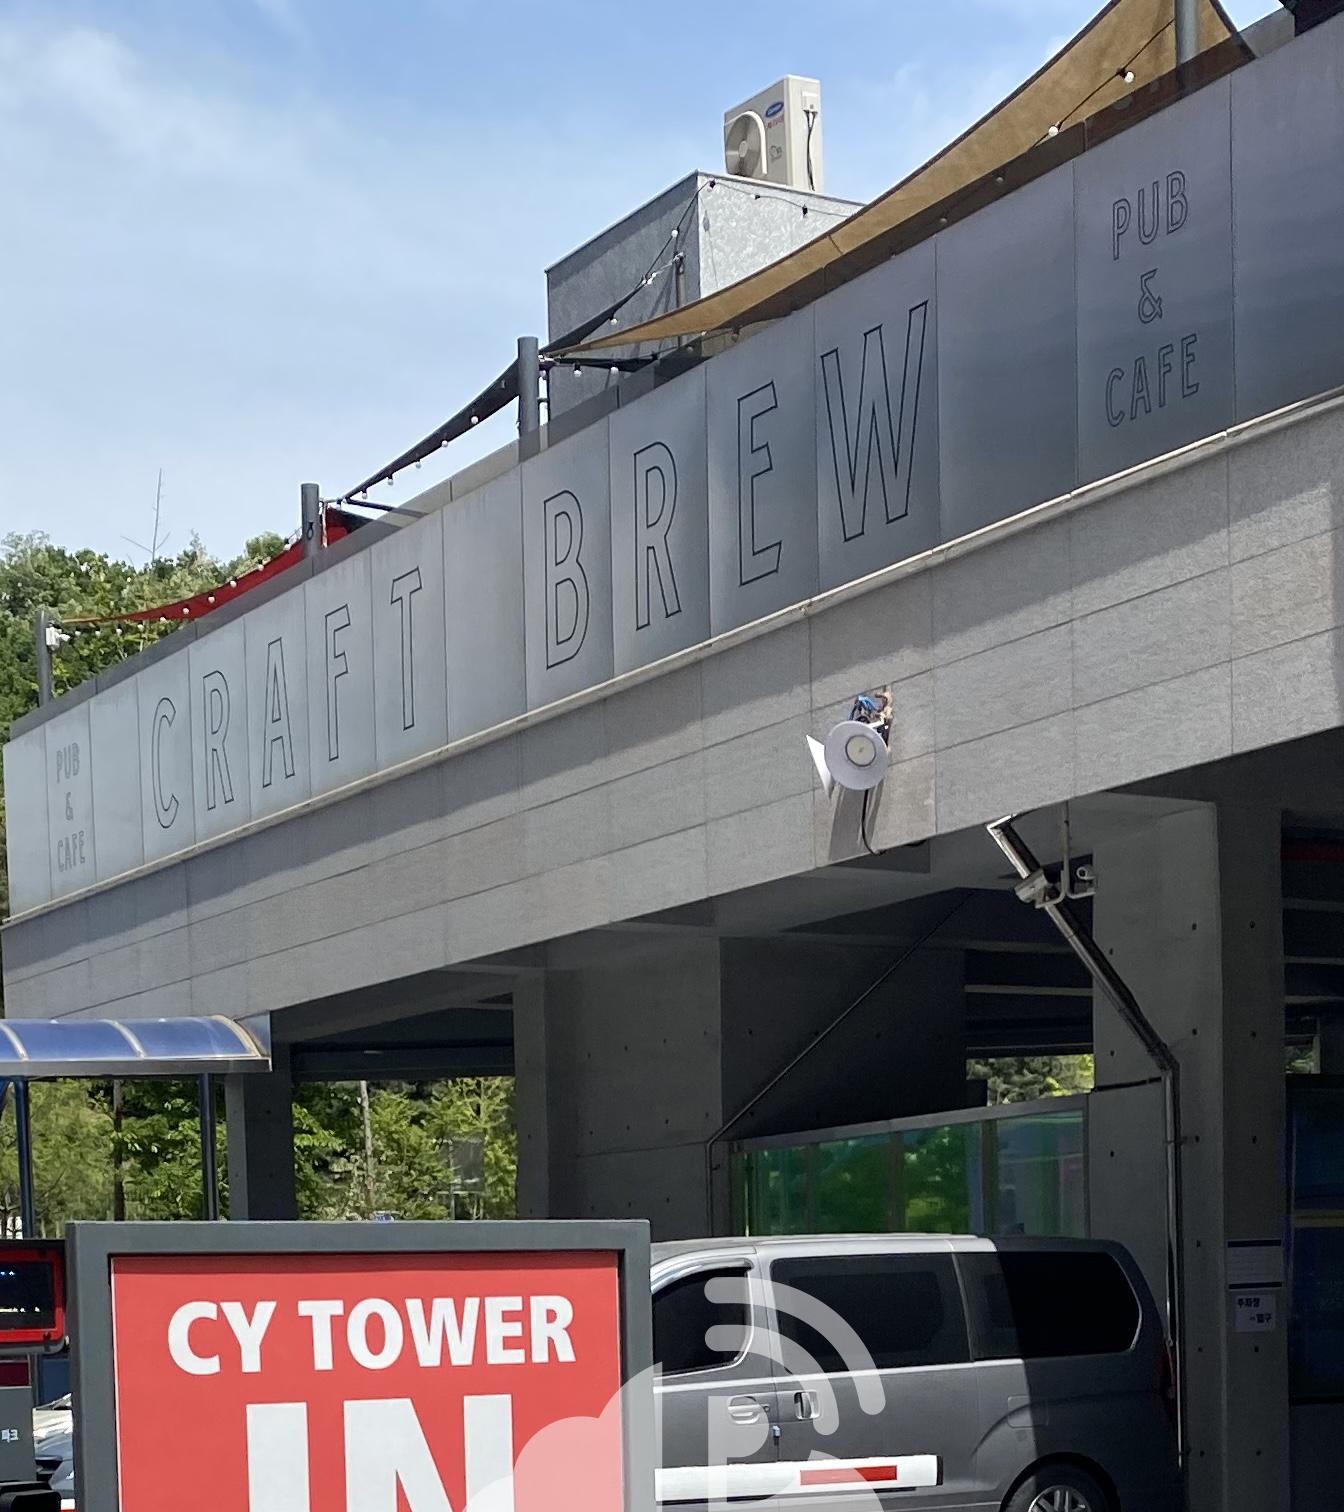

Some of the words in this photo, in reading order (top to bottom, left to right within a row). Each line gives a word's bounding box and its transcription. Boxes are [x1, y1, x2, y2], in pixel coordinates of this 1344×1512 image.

[1112, 170, 1189, 261] PUB
[1137, 268, 1163, 325] &
[1104, 333, 1199, 428] CAFE
[150, 566, 423, 829] CRAFT
[543, 299, 928, 669] BREW
[56, 742, 80, 784] PUB
[57, 830, 85, 872] CAFE
[167, 1300, 277, 1375] CY
[297, 1295, 576, 1371] TOWER
